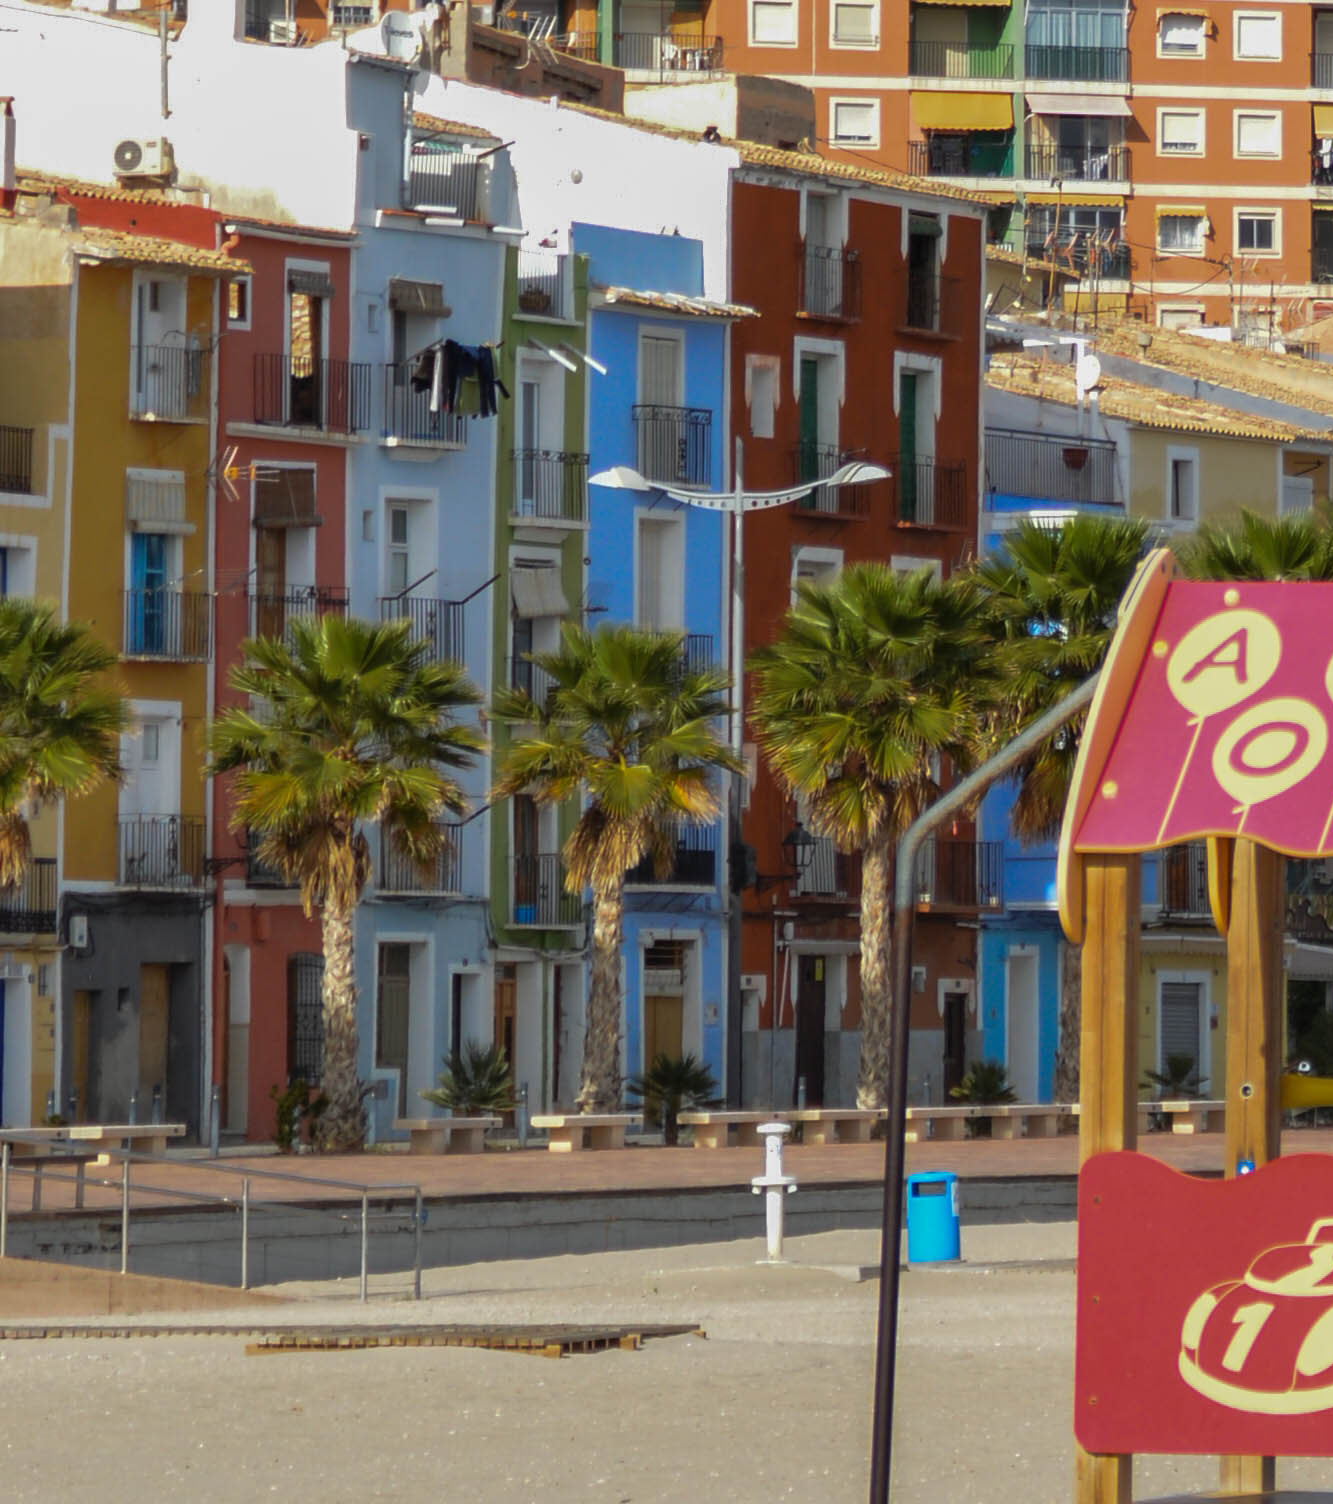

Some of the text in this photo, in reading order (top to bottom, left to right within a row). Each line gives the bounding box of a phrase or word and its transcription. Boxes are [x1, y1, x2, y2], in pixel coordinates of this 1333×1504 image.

[1181, 627, 1248, 684] A
[1228, 721, 1310, 777] O
[1221, 1301, 1276, 1373] 1
